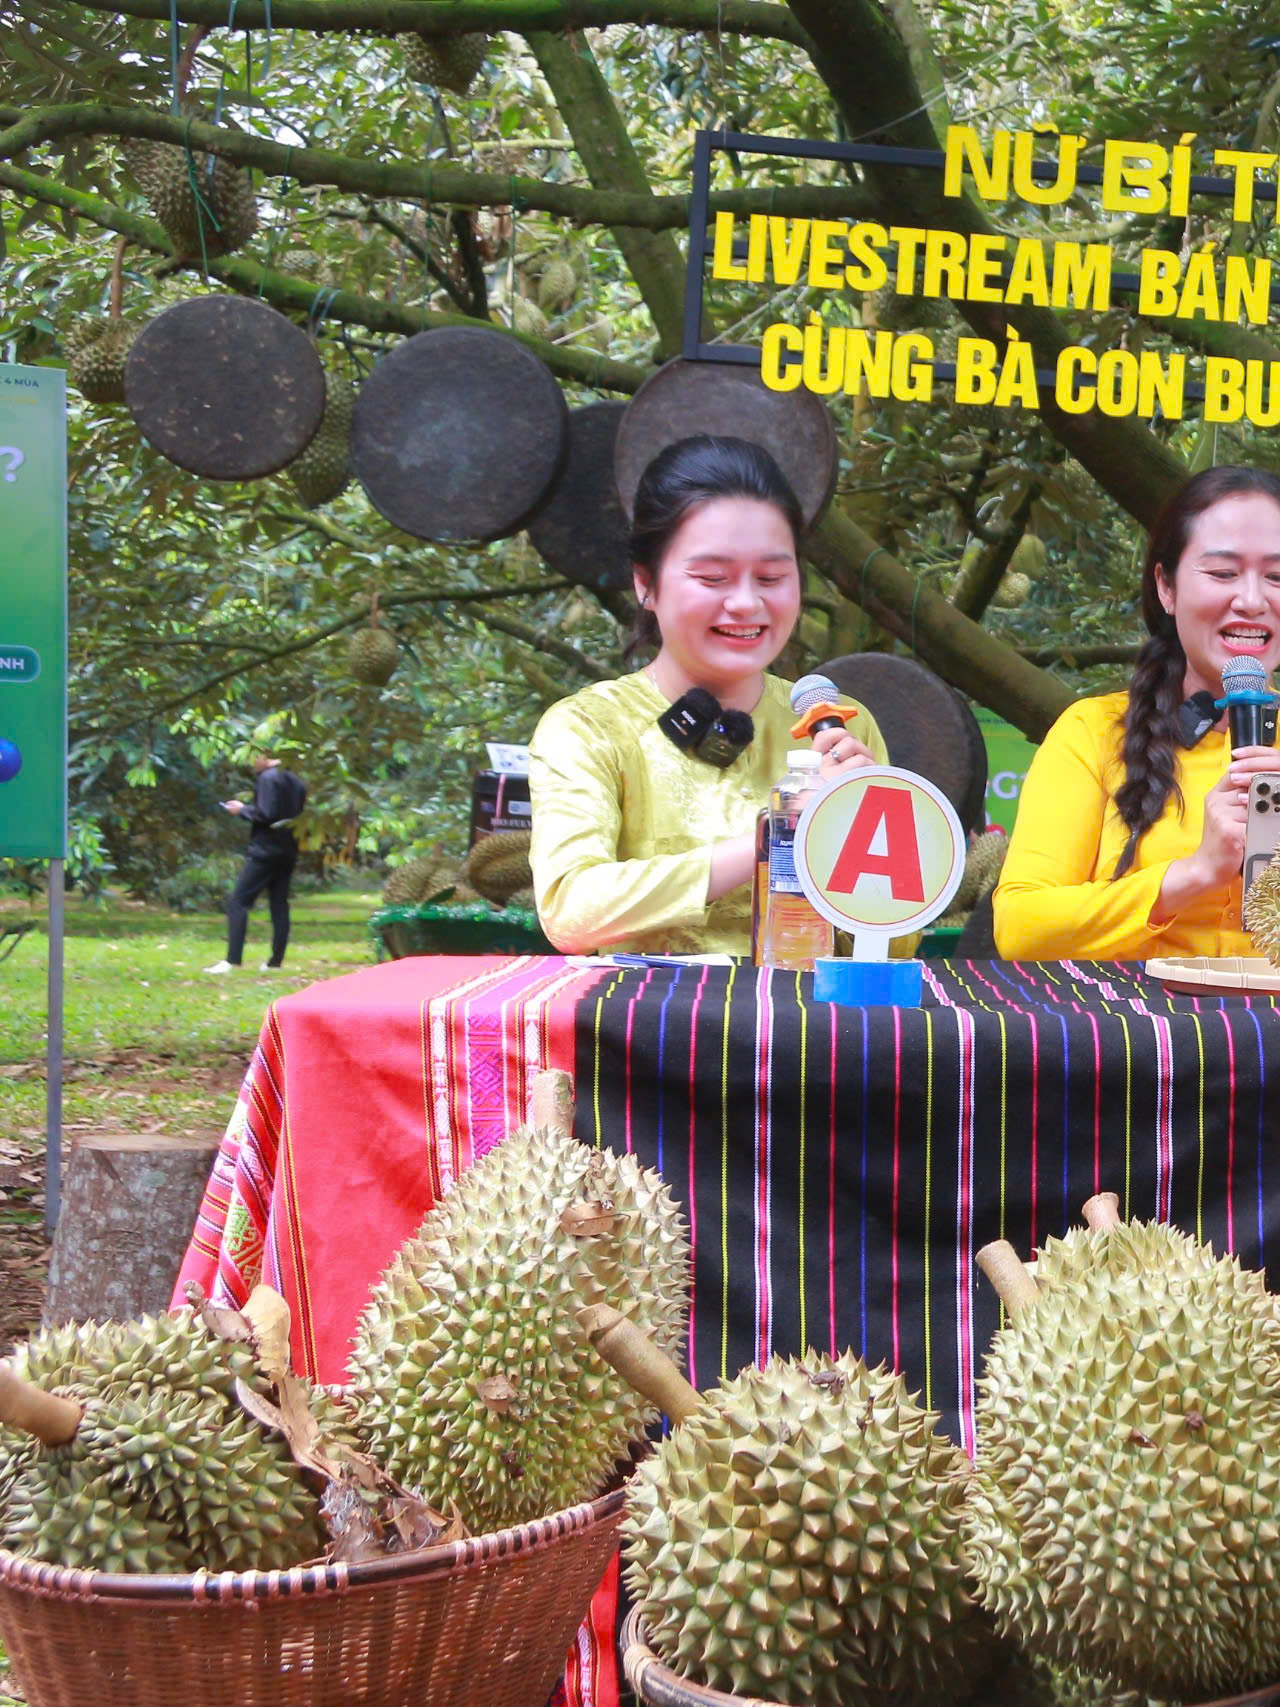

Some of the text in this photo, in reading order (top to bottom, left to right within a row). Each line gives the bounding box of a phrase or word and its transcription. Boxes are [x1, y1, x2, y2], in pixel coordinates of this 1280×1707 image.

[945, 122, 1086, 204] NỮ
[1103, 132, 1193, 216] BÍ
[712, 211, 1112, 311] LIVESTREAM
[1138, 243, 1271, 325] BÁN
[761, 311, 934, 401] CÙNG
[956, 325, 1039, 409] BÀ
[1055, 346, 1184, 419] CON
[826, 785, 925, 903] A
